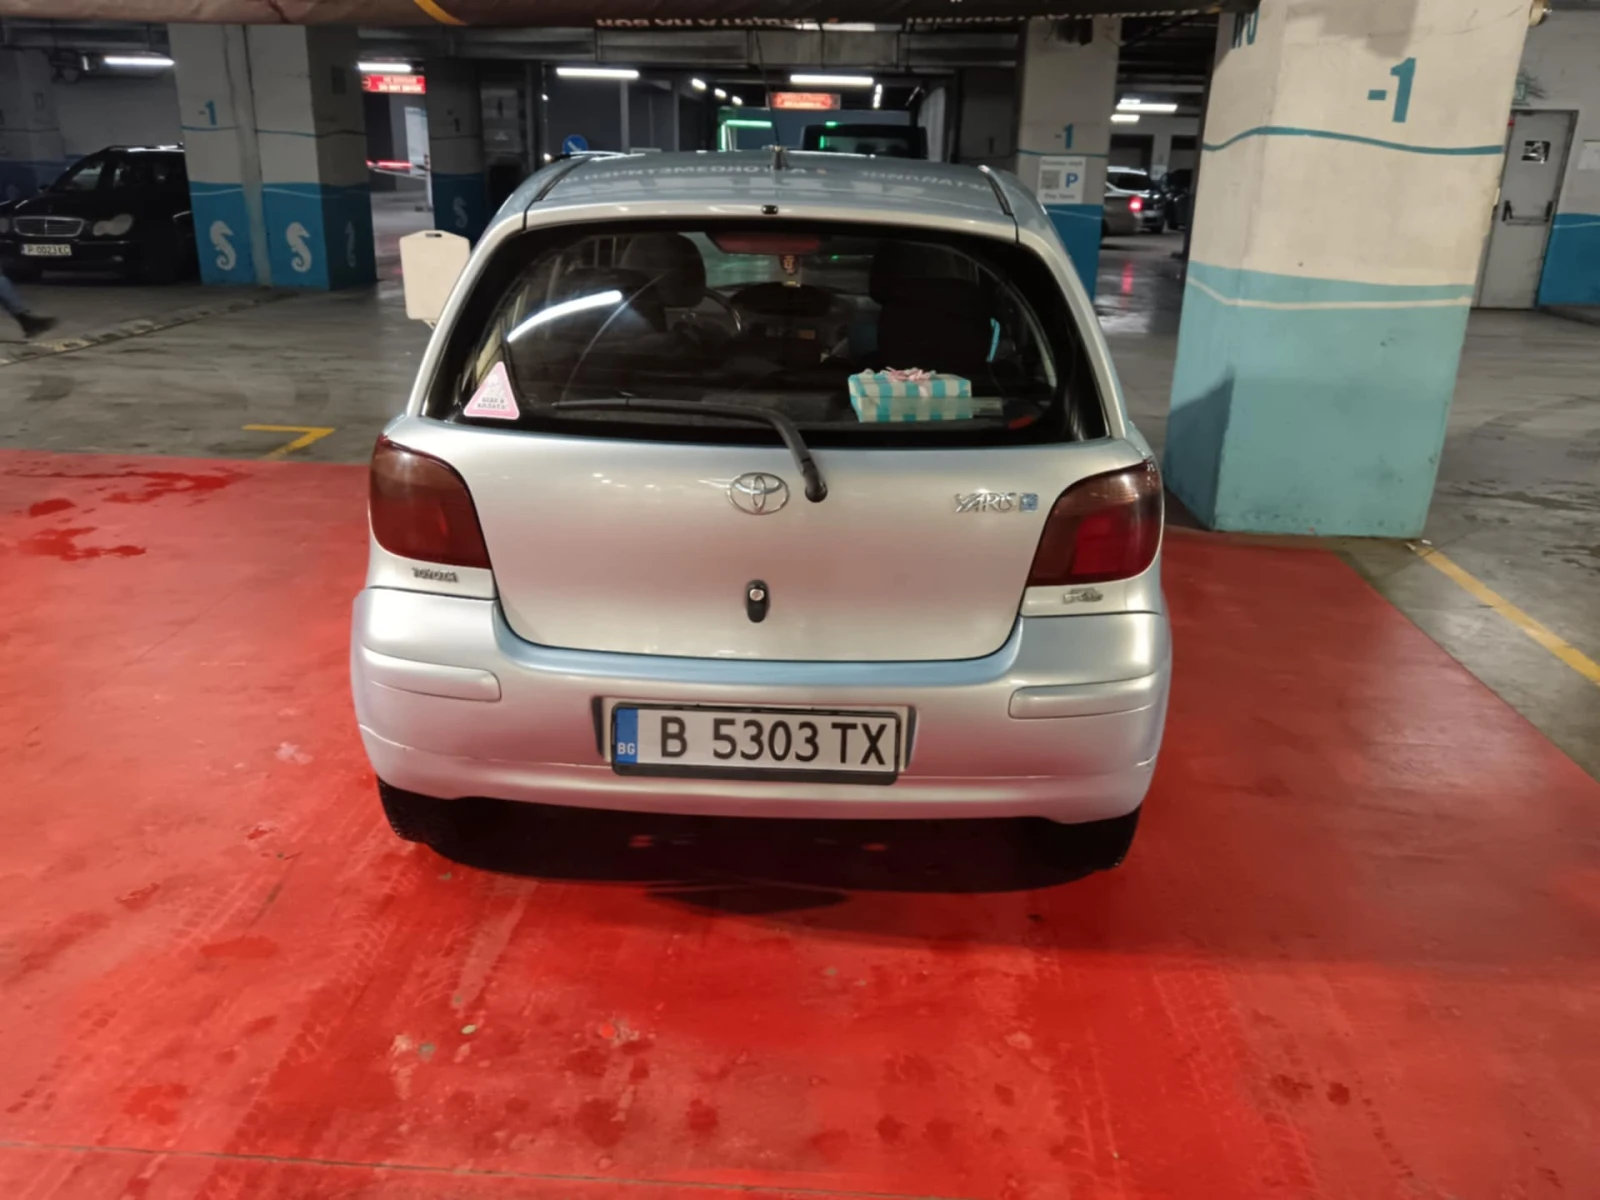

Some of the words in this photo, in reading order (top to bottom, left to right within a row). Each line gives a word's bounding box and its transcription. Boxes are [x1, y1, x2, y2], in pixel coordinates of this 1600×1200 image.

[1367, 57, 1416, 123] -1
[198, 100, 217, 126] -1
[1054, 122, 1074, 149] -1
[1065, 172, 1078, 188] P
[954, 492, 1016, 513] YARIS
[617, 743, 636, 755] BG
[660, 716, 688, 758] B
[712, 718, 820, 762] 5303
[831, 722, 887, 765] TX
